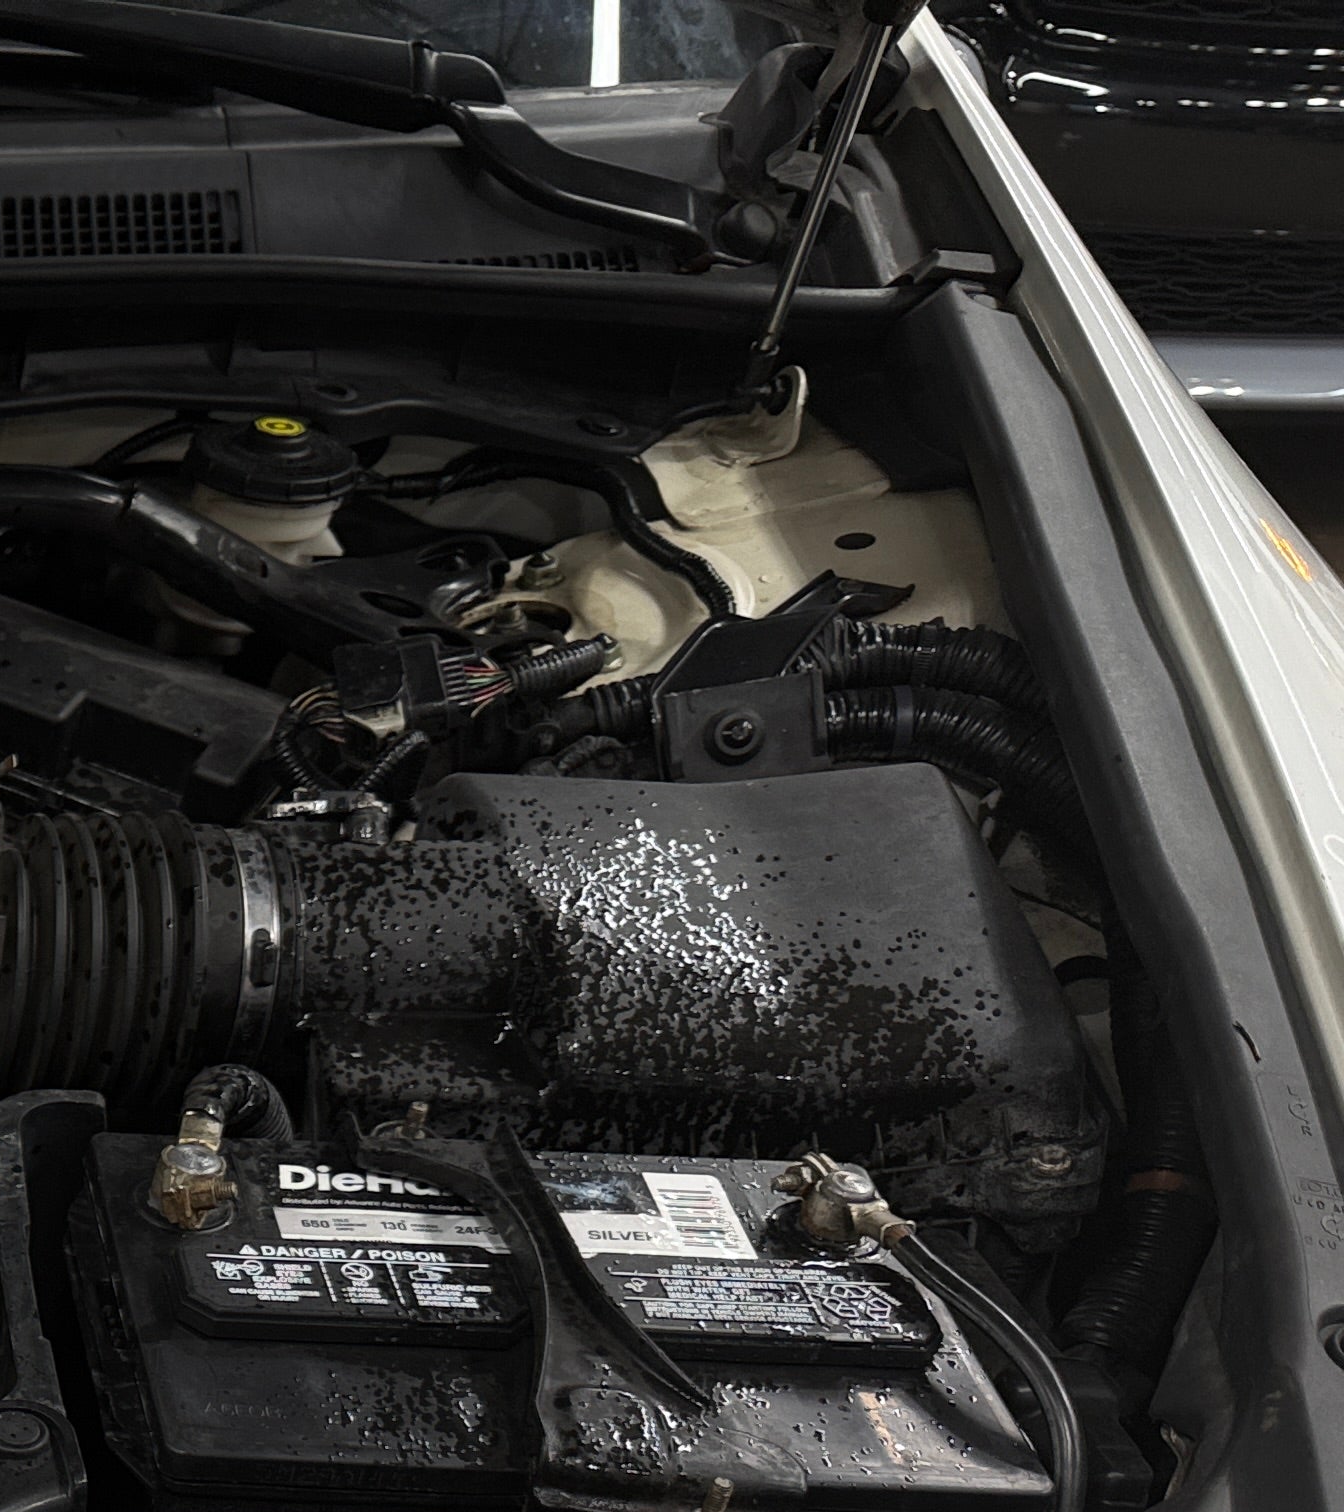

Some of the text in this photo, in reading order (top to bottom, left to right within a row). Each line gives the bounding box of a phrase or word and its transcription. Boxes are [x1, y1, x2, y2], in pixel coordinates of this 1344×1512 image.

[278, 1164, 453, 1196] DieHa
[301, 1219, 330, 1229] 650
[261, 1245, 348, 1259] DANGER
[368, 1250, 446, 1262] POISON
